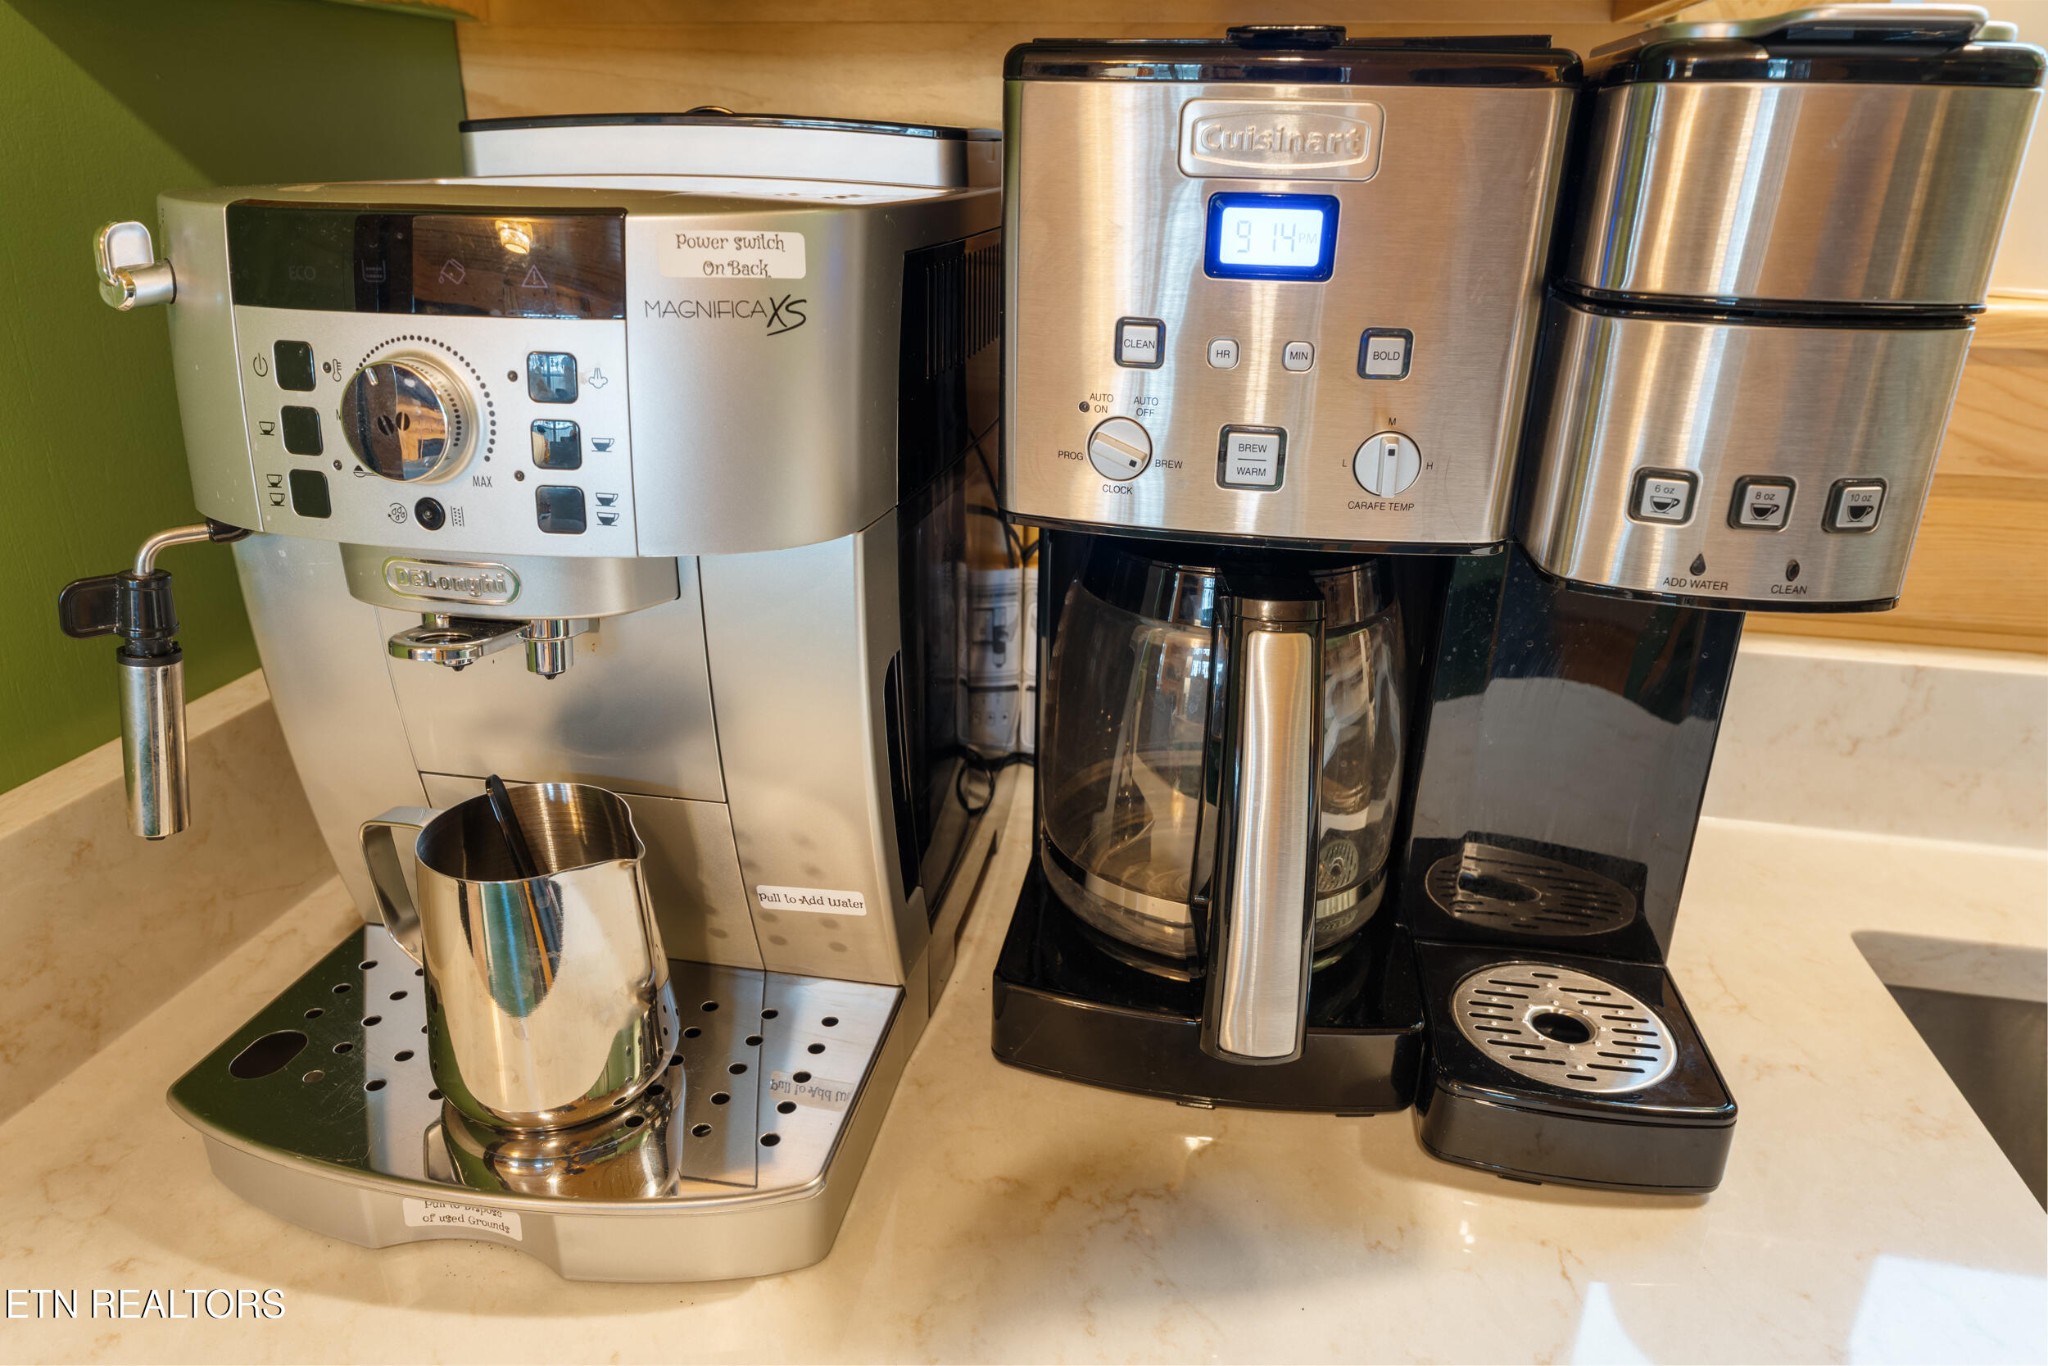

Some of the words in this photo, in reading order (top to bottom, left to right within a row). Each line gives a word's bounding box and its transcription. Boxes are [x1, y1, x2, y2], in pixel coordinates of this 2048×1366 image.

[1201, 125, 1360, 155] Cuisinart
[675, 233, 729, 250] Power
[1298, 232, 1318, 244] PM
[288, 266, 316, 281] ECO
[702, 260, 725, 276] On
[727, 259, 771, 278] Back
[1123, 339, 1156, 350] CLEAN
[1216, 350, 1231, 360] HR
[1289, 351, 1309, 361] MIN
[1372, 350, 1401, 361] BOLD
[1089, 393, 1114, 403] AUTO
[1133, 396, 1159, 406] AUTO
[1094, 404, 1108, 414] ON
[1136, 407, 1155, 417] OFF
[1388, 417, 1397, 426] M
[1238, 443, 1268, 453] BREW
[1057, 450, 1084, 461] PROG
[1154, 459, 1183, 469] BREW
[1342, 459, 1348, 467] L
[1426, 462, 1434, 470] H
[1236, 466, 1267, 477] WARM
[472, 475, 493, 488] MAX
[1102, 484, 1133, 495] CLOCK
[1654, 484, 1661, 493] 6
[1755, 491, 1762, 500] 8
[1763, 493, 1775, 501] oz
[1850, 493, 1860, 502] 10
[1861, 494, 1872, 502] oz
[1347, 501, 1386, 511] CARAFE
[1388, 502, 1415, 512] TEMP
[1663, 577, 1687, 588] ADD
[1690, 579, 1729, 591] WATER
[1770, 584, 1808, 595] CLEAN
[758, 892, 781, 903] Pull
[784, 893, 797, 904] to
[799, 895, 825, 906] Add
[827, 897, 864, 909] Water
[422, 1213, 436, 1223] of
[439, 1214, 465, 1223] used
[467, 1215, 511, 1233] Grounds
